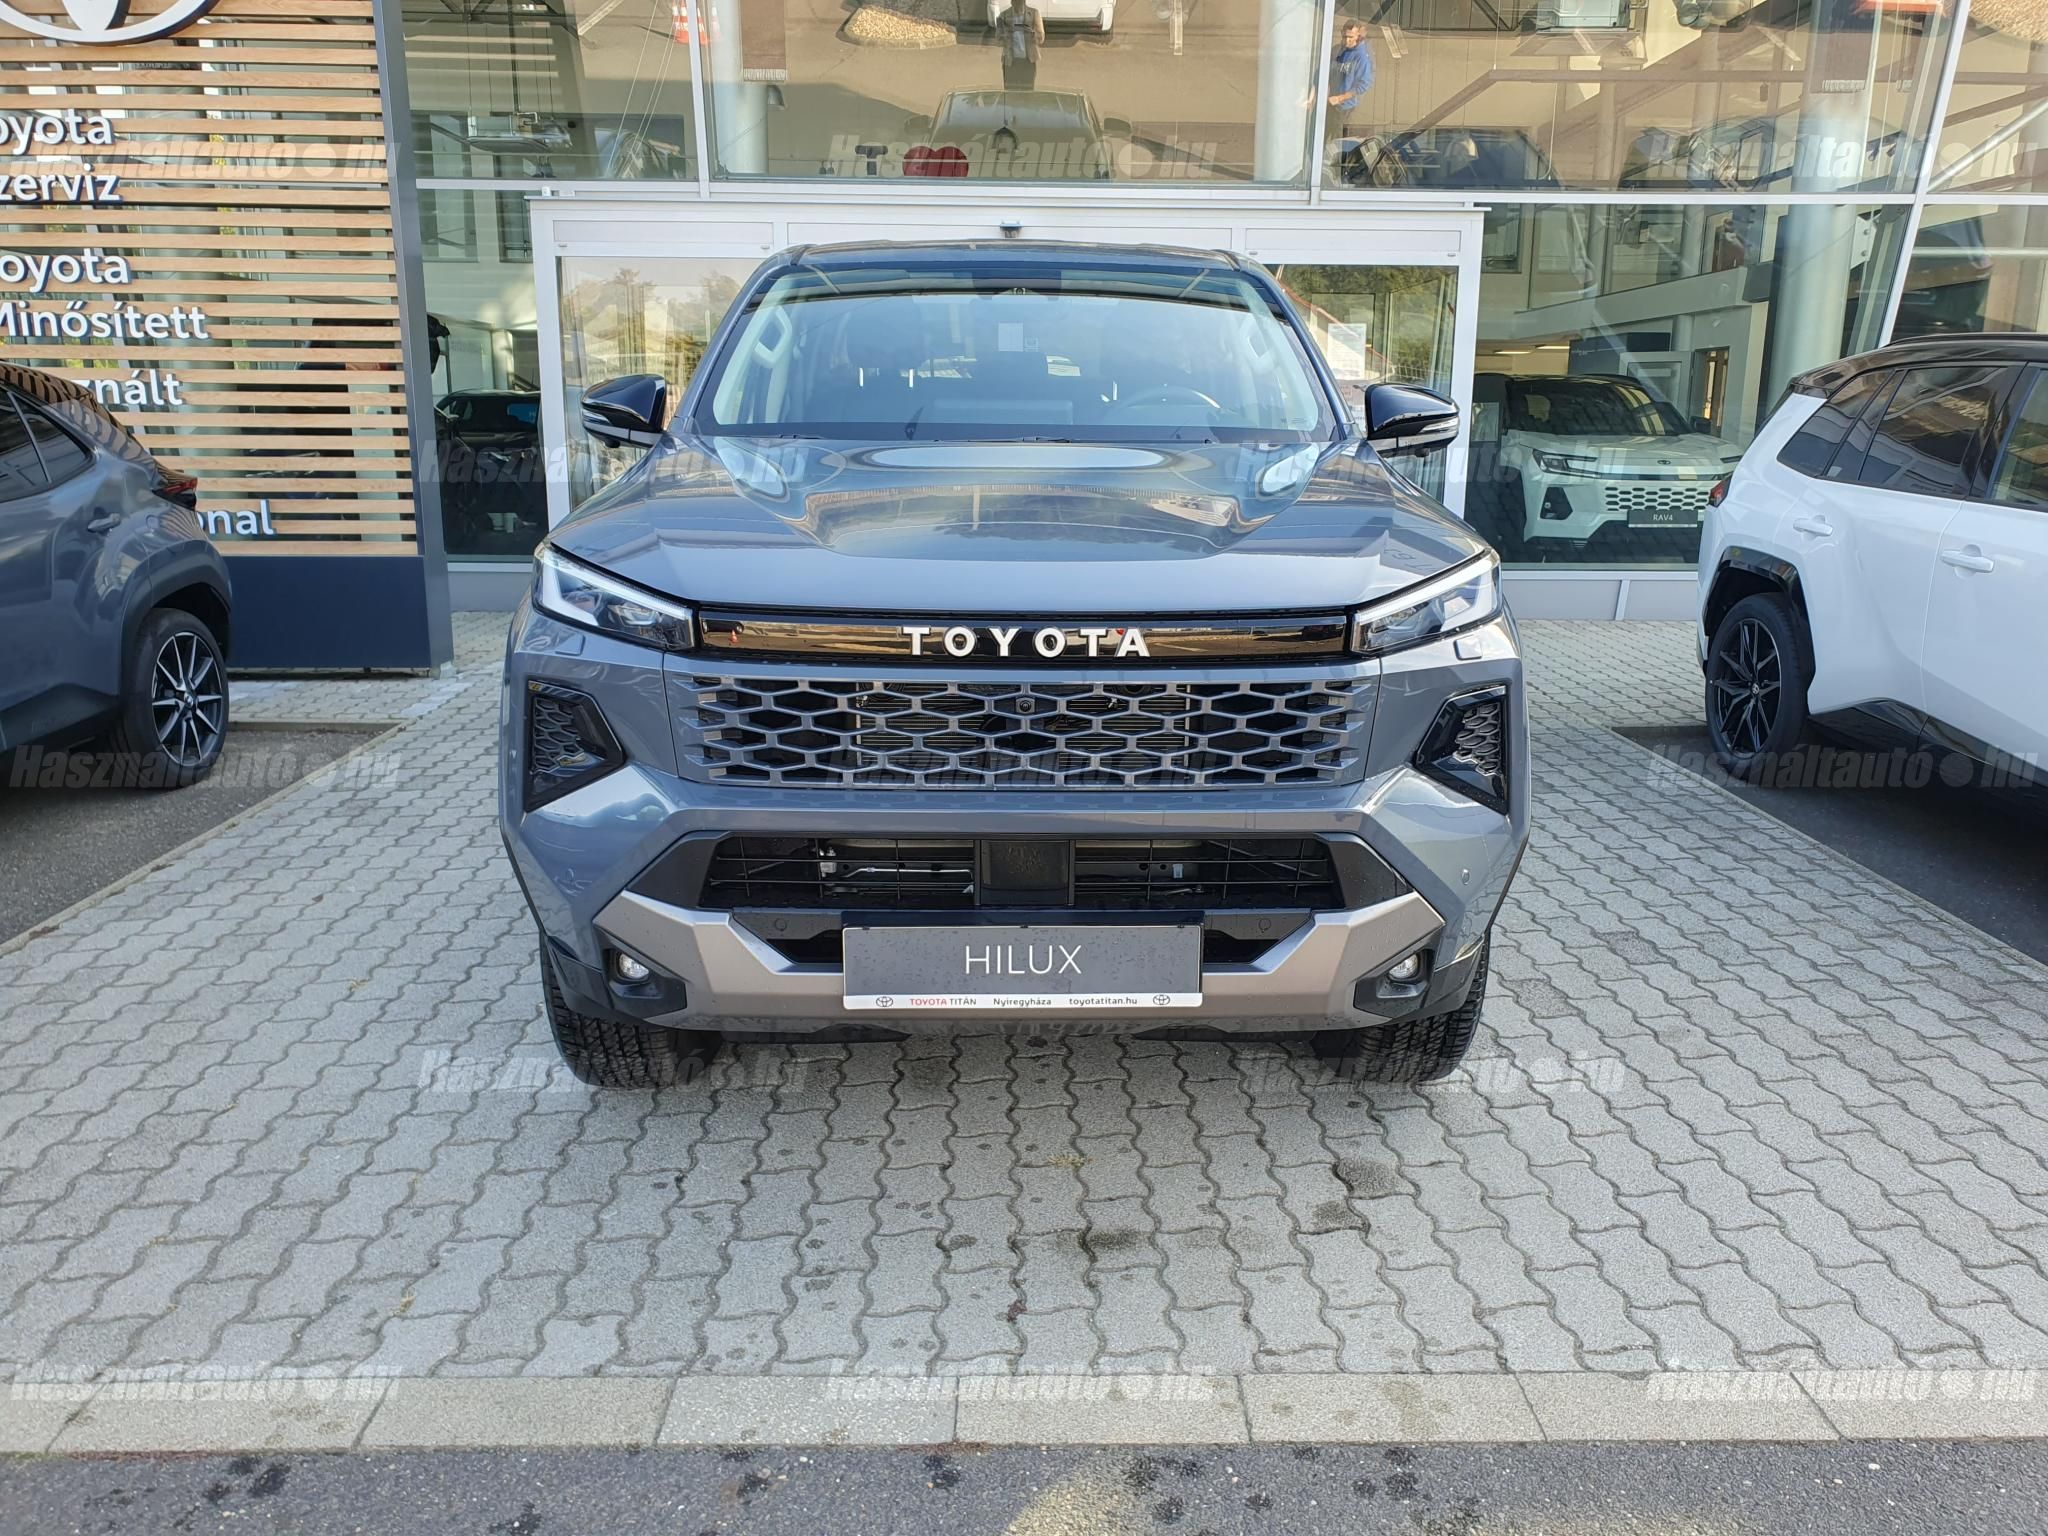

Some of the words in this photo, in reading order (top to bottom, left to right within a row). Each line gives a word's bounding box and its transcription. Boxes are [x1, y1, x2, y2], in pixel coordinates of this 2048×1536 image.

[1652, 513, 1674, 521] RAV4
[902, 625, 1151, 659] TOYOTA
[964, 944, 1082, 975] HILUX
[909, 998, 947, 1006] TOYOTA
[949, 996, 977, 1006] TITÁN
[993, 997, 1052, 1008] Nyíregyháza
[1068, 996, 1138, 1007] toyotatitan.hu
